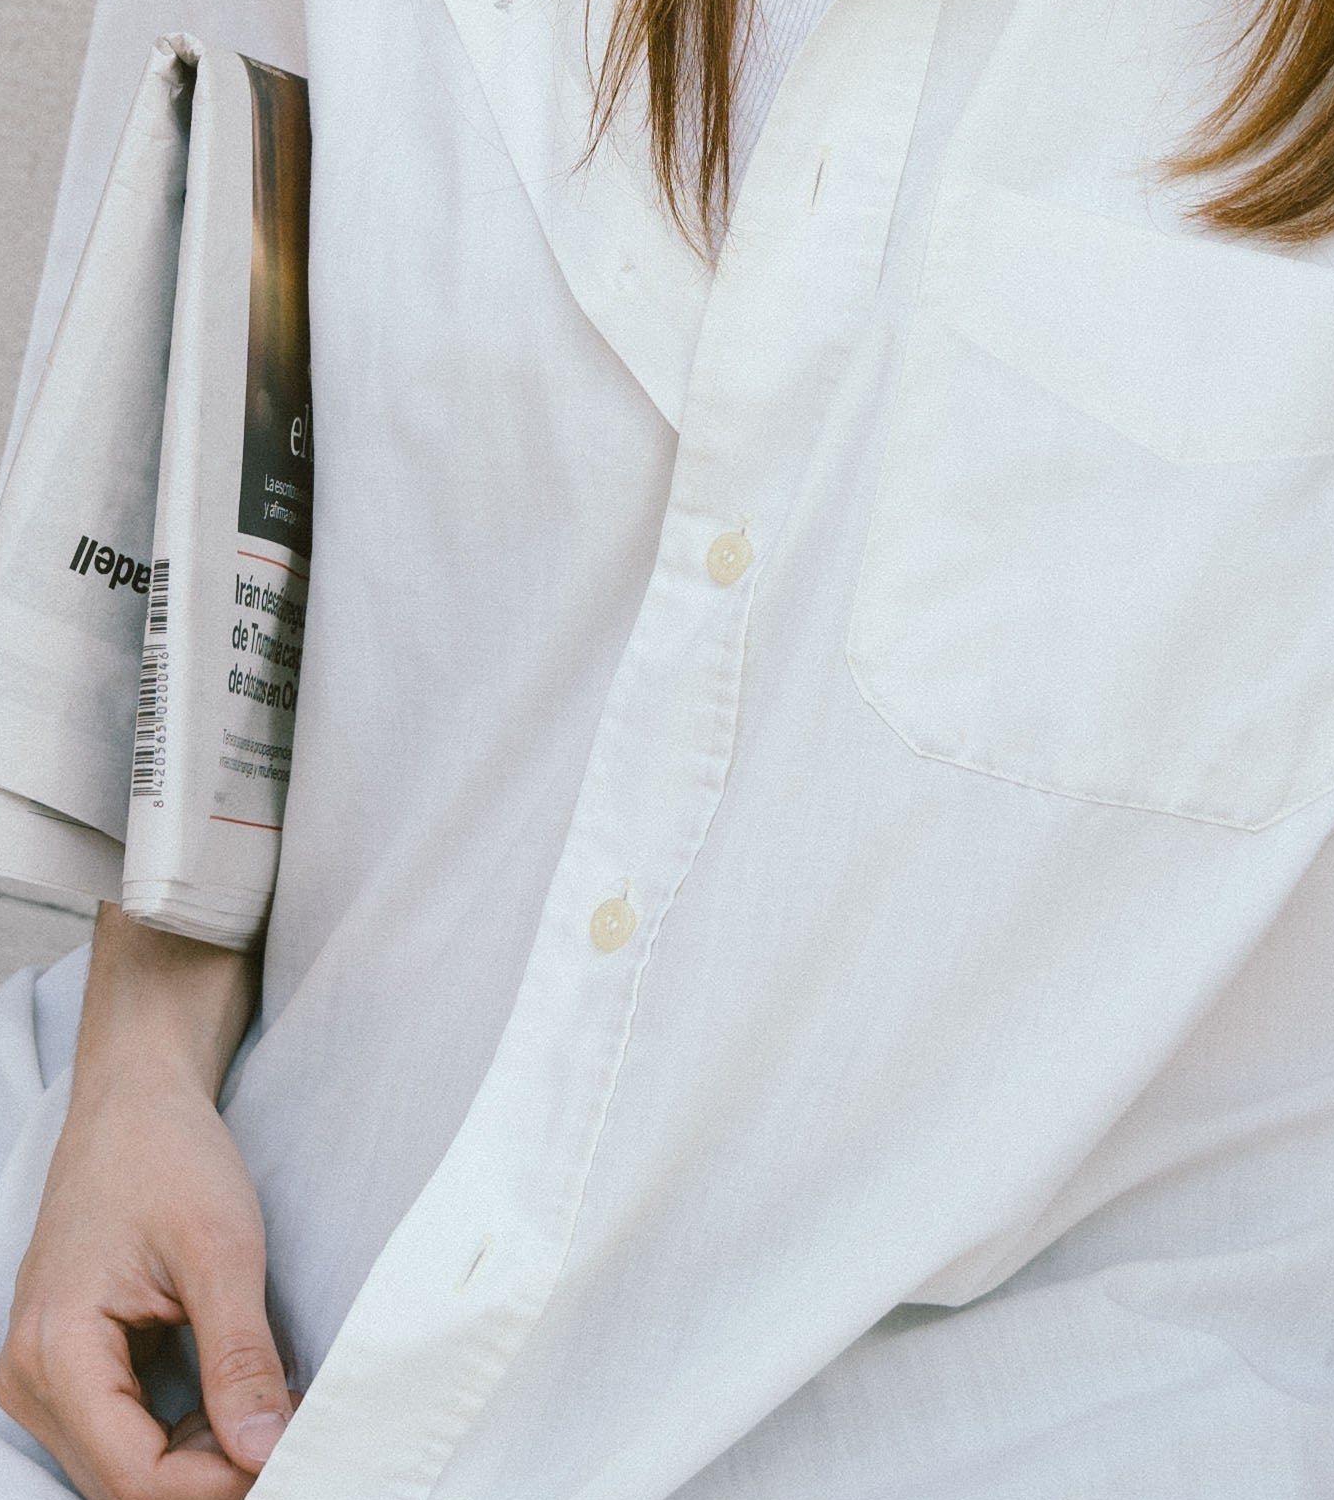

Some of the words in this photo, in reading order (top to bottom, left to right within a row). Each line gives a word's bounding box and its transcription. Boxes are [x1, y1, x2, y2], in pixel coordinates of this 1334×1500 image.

[234, 573, 261, 611] Irán
[232, 618, 249, 652] de
[156, 651, 170, 716] 020046
[228, 662, 243, 695] de
[154, 724, 167, 789] 420565
[153, 799, 165, 809] 8
